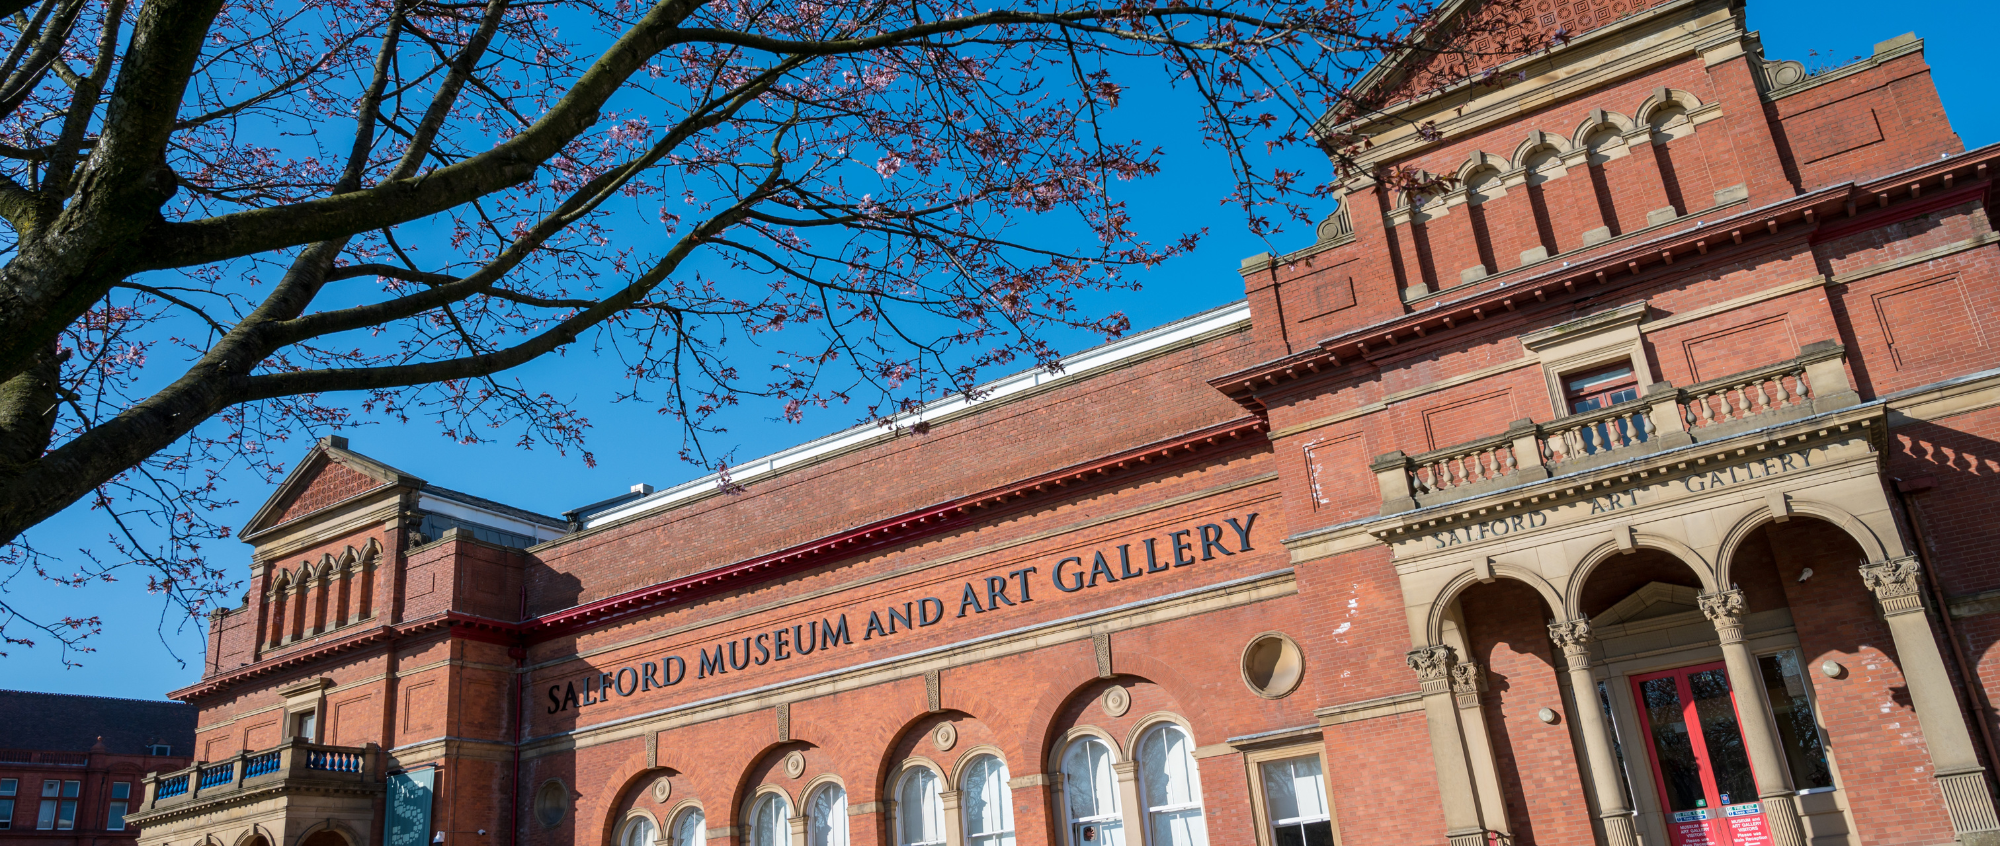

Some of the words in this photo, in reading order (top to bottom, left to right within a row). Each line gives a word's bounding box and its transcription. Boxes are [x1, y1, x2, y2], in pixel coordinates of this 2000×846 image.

[1433, 511, 1547, 549] SALFORD
[1591, 487, 1639, 515] ART
[1684, 449, 1812, 492] GALLERY
[548, 654, 686, 714] SALFORD
[698, 613, 851, 679] MUSEUM
[863, 597, 944, 640] AND
[956, 566, 1037, 618] ART
[1052, 513, 1260, 592] GALLERY
